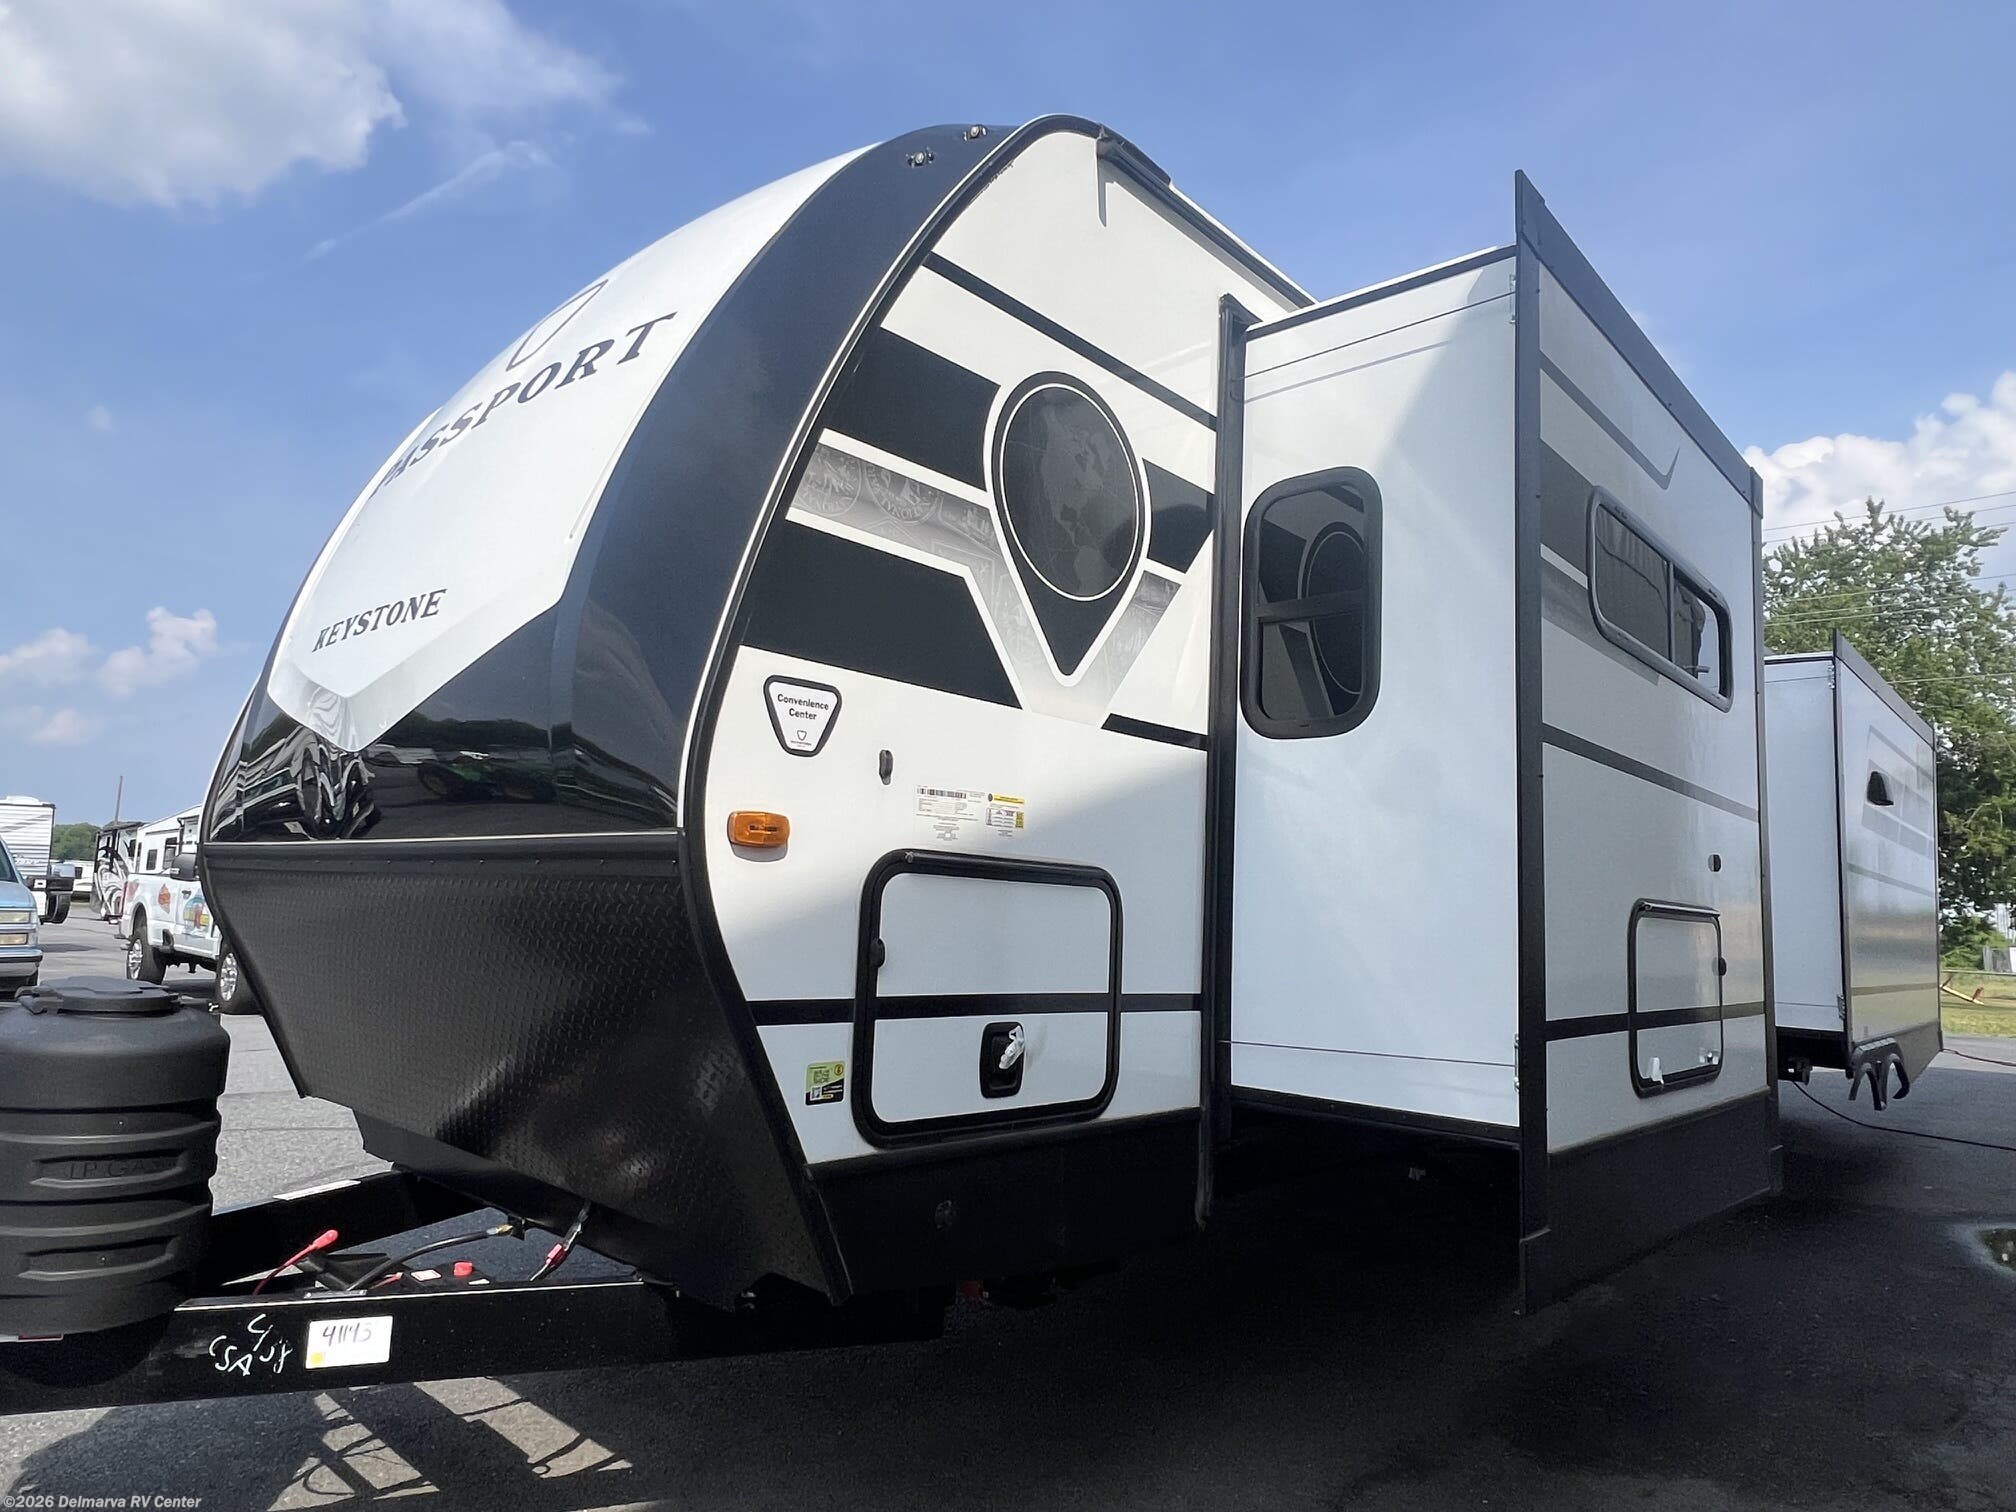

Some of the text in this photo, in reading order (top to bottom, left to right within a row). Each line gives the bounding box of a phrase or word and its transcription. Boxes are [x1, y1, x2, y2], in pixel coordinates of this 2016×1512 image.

[368, 312, 677, 500] PASSPORT
[312, 588, 447, 653] KEYSTONE
[777, 693, 829, 711] Convenience
[788, 707, 817, 720] Center
